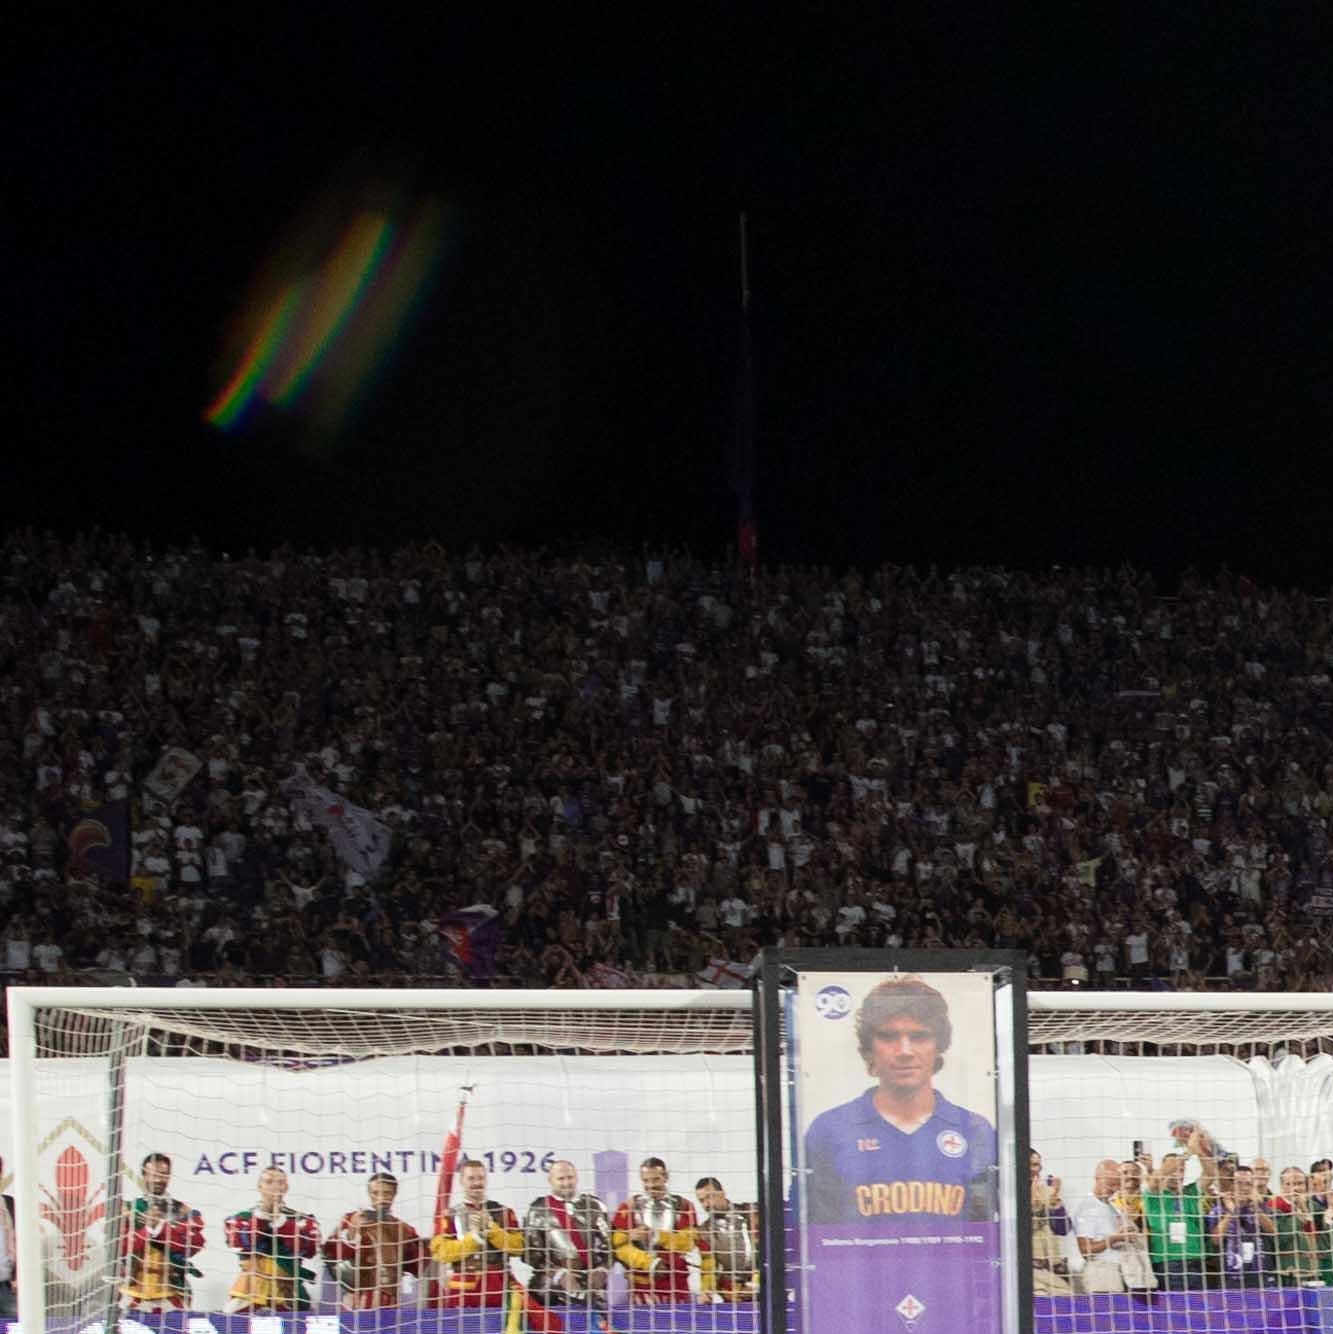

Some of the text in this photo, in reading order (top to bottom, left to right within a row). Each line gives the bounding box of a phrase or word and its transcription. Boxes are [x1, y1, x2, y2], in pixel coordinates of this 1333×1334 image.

[193, 1151, 260, 1175] ACF
[484, 1151, 556, 1173] 1926
[855, 1180, 966, 1218] CRODINO
